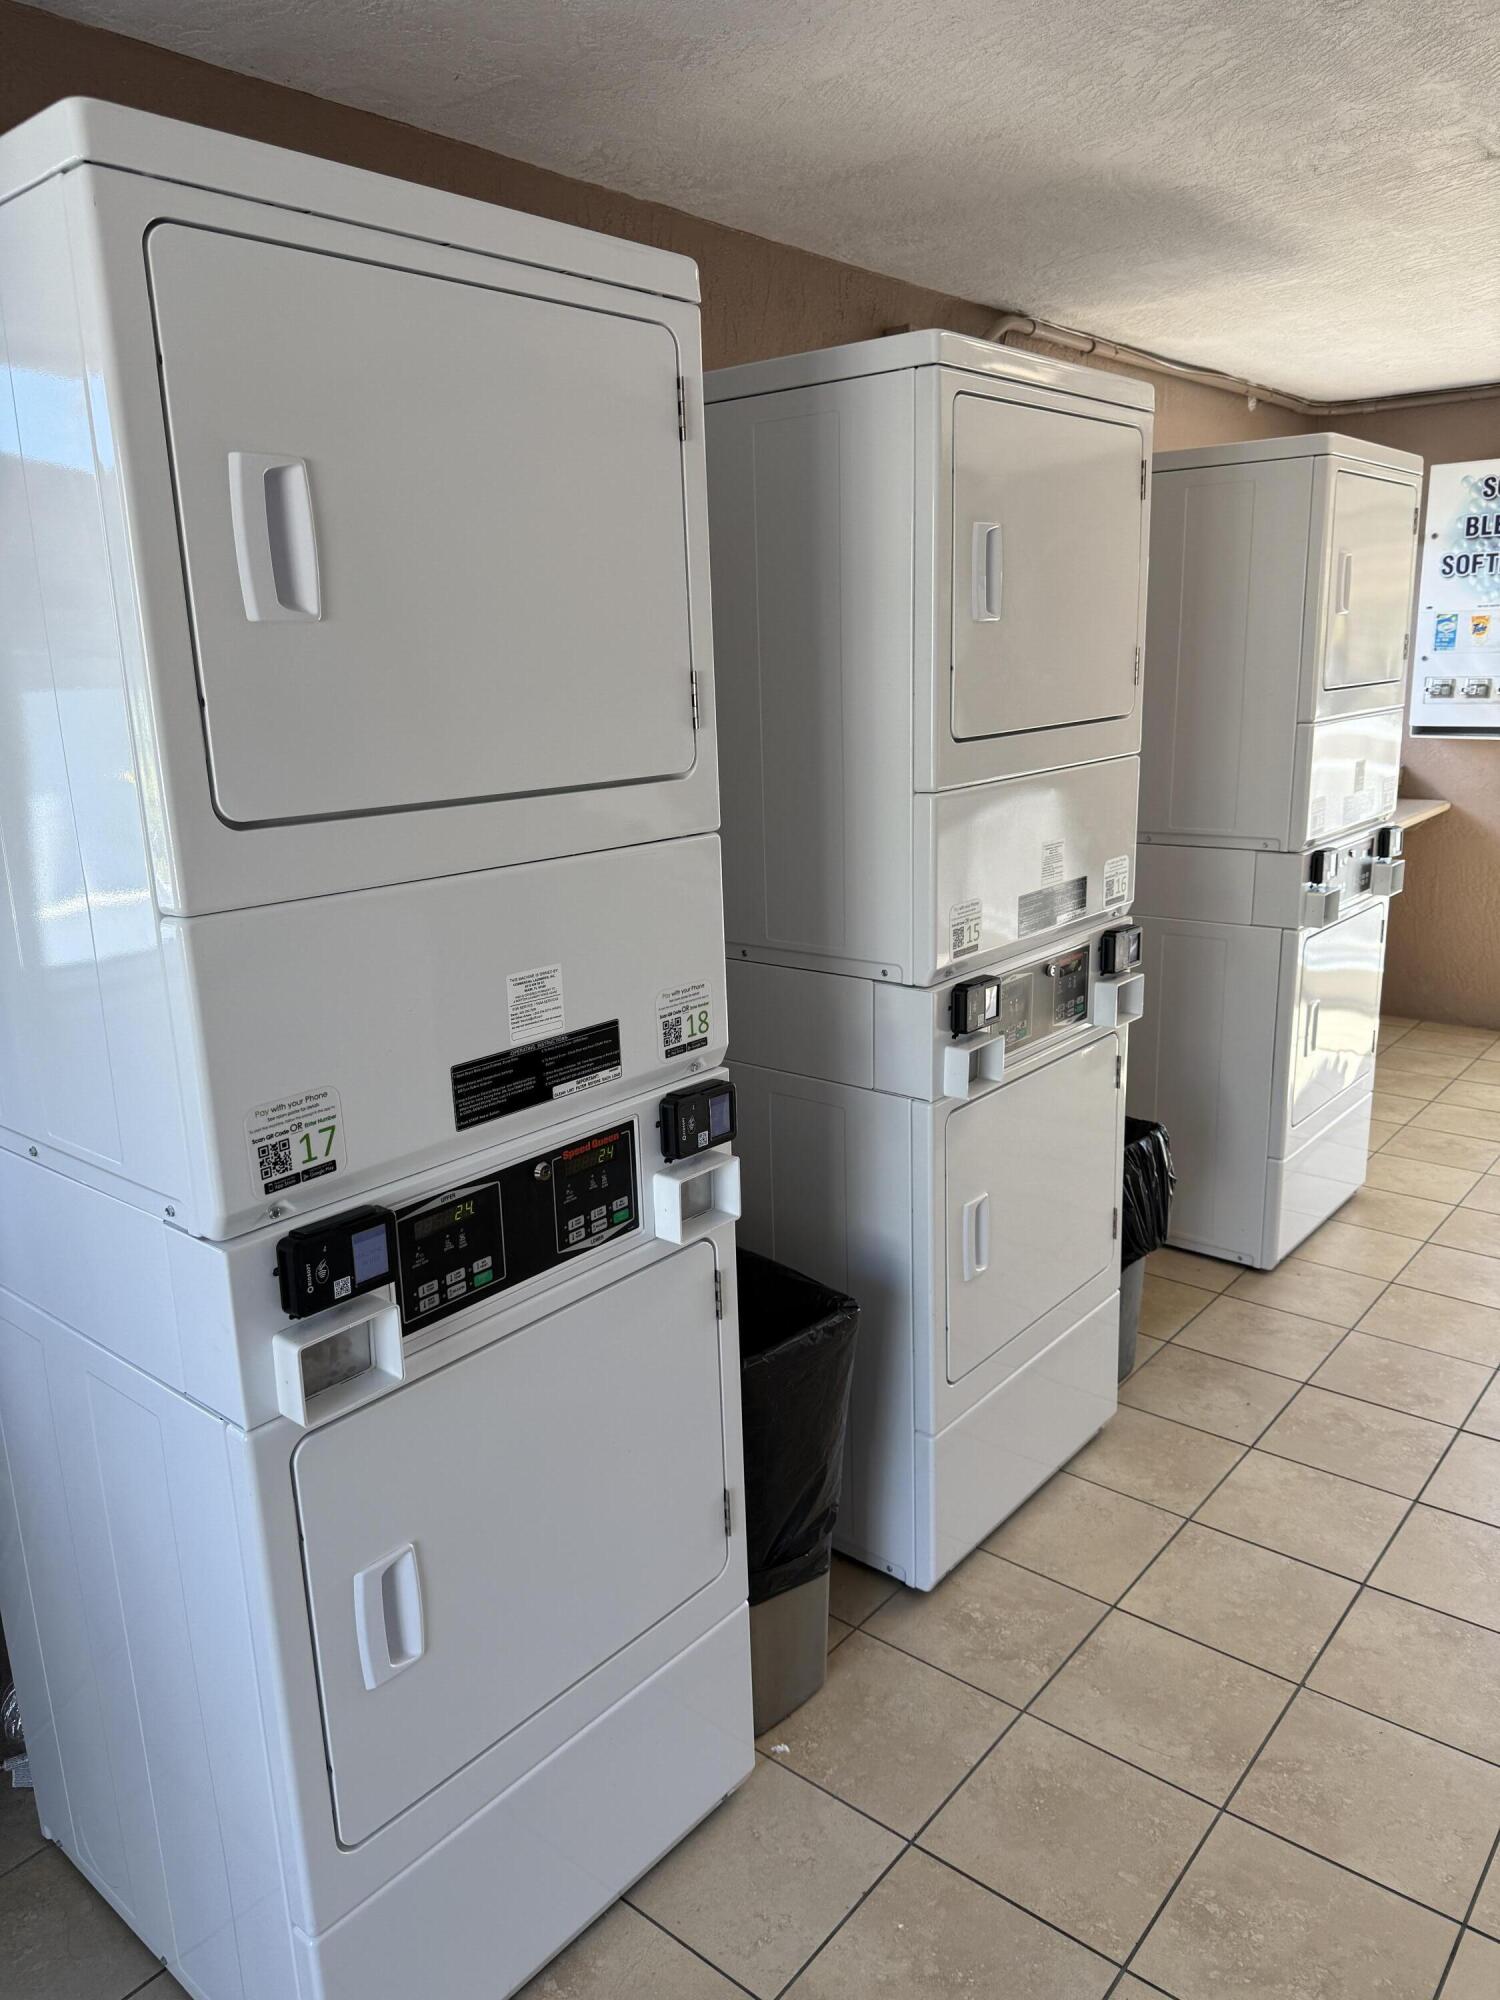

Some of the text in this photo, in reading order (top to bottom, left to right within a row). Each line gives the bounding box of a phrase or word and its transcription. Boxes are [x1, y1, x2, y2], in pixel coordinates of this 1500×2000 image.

[1482, 476, 1500, 498] S
[1441, 553, 1500, 576] SOFT
[1115, 876, 1127, 894] 16
[966, 923, 980, 943] 15
[681, 1005, 690, 1013] OR
[686, 1010, 709, 1038] 18
[254, 1108, 269, 1119] Pay
[270, 1102, 286, 1113] with
[287, 1099, 303, 1110] your
[304, 1091, 328, 1104] Phone
[251, 1136, 265, 1145] Scan
[266, 1133, 274, 1141] QR
[274, 1129, 290, 1138] Code
[289, 1122, 303, 1132] OR
[317, 1114, 337, 1123] Number
[299, 1124, 336, 1165] 17
[562, 1133, 620, 1160] Speed Queen
[598, 1145, 615, 1164] 24
[440, 1192, 456, 1204] UPPER
[454, 1200, 476, 1221] 24
